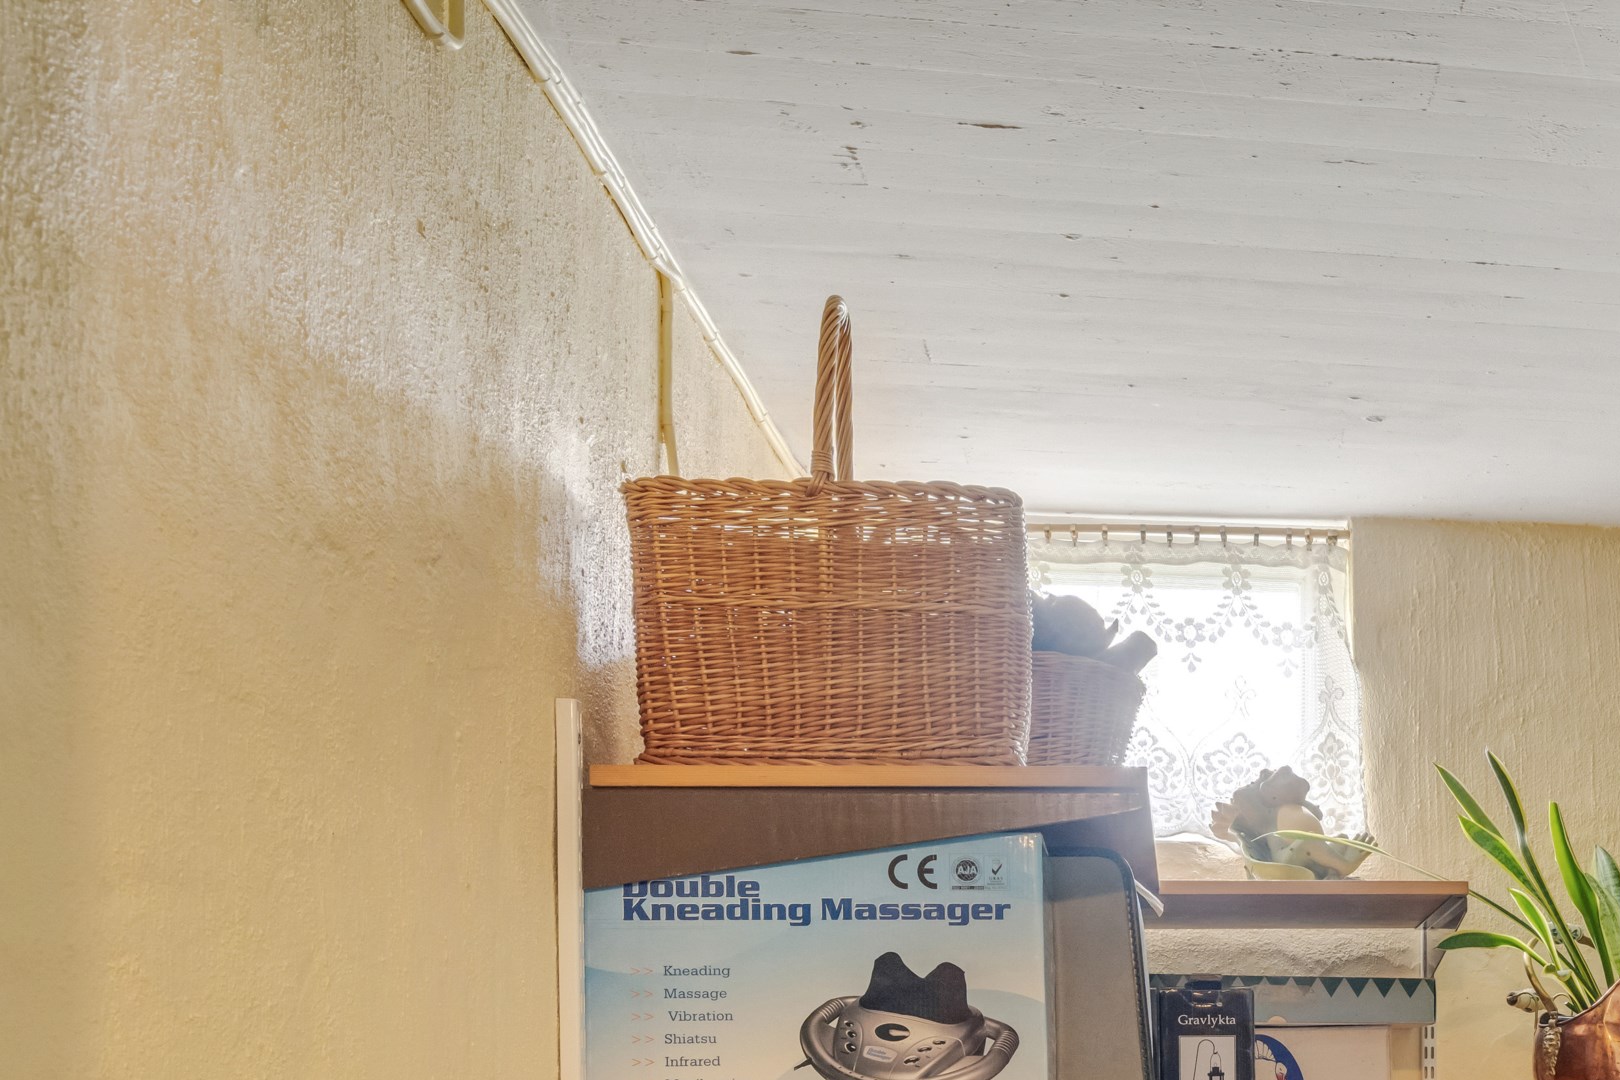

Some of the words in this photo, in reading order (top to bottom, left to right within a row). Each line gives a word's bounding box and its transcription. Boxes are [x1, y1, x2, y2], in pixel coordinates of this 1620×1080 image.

[623, 898, 811, 926] Kneading
[821, 897, 1011, 926] Massager
[663, 965, 730, 978] Kneading
[664, 988, 727, 1001] Massage
[668, 1010, 733, 1021] Vibration
[1177, 1013, 1237, 1027] Gravlykta
[664, 1033, 717, 1044] Shiatsu
[665, 1056, 720, 1067] Infrared
